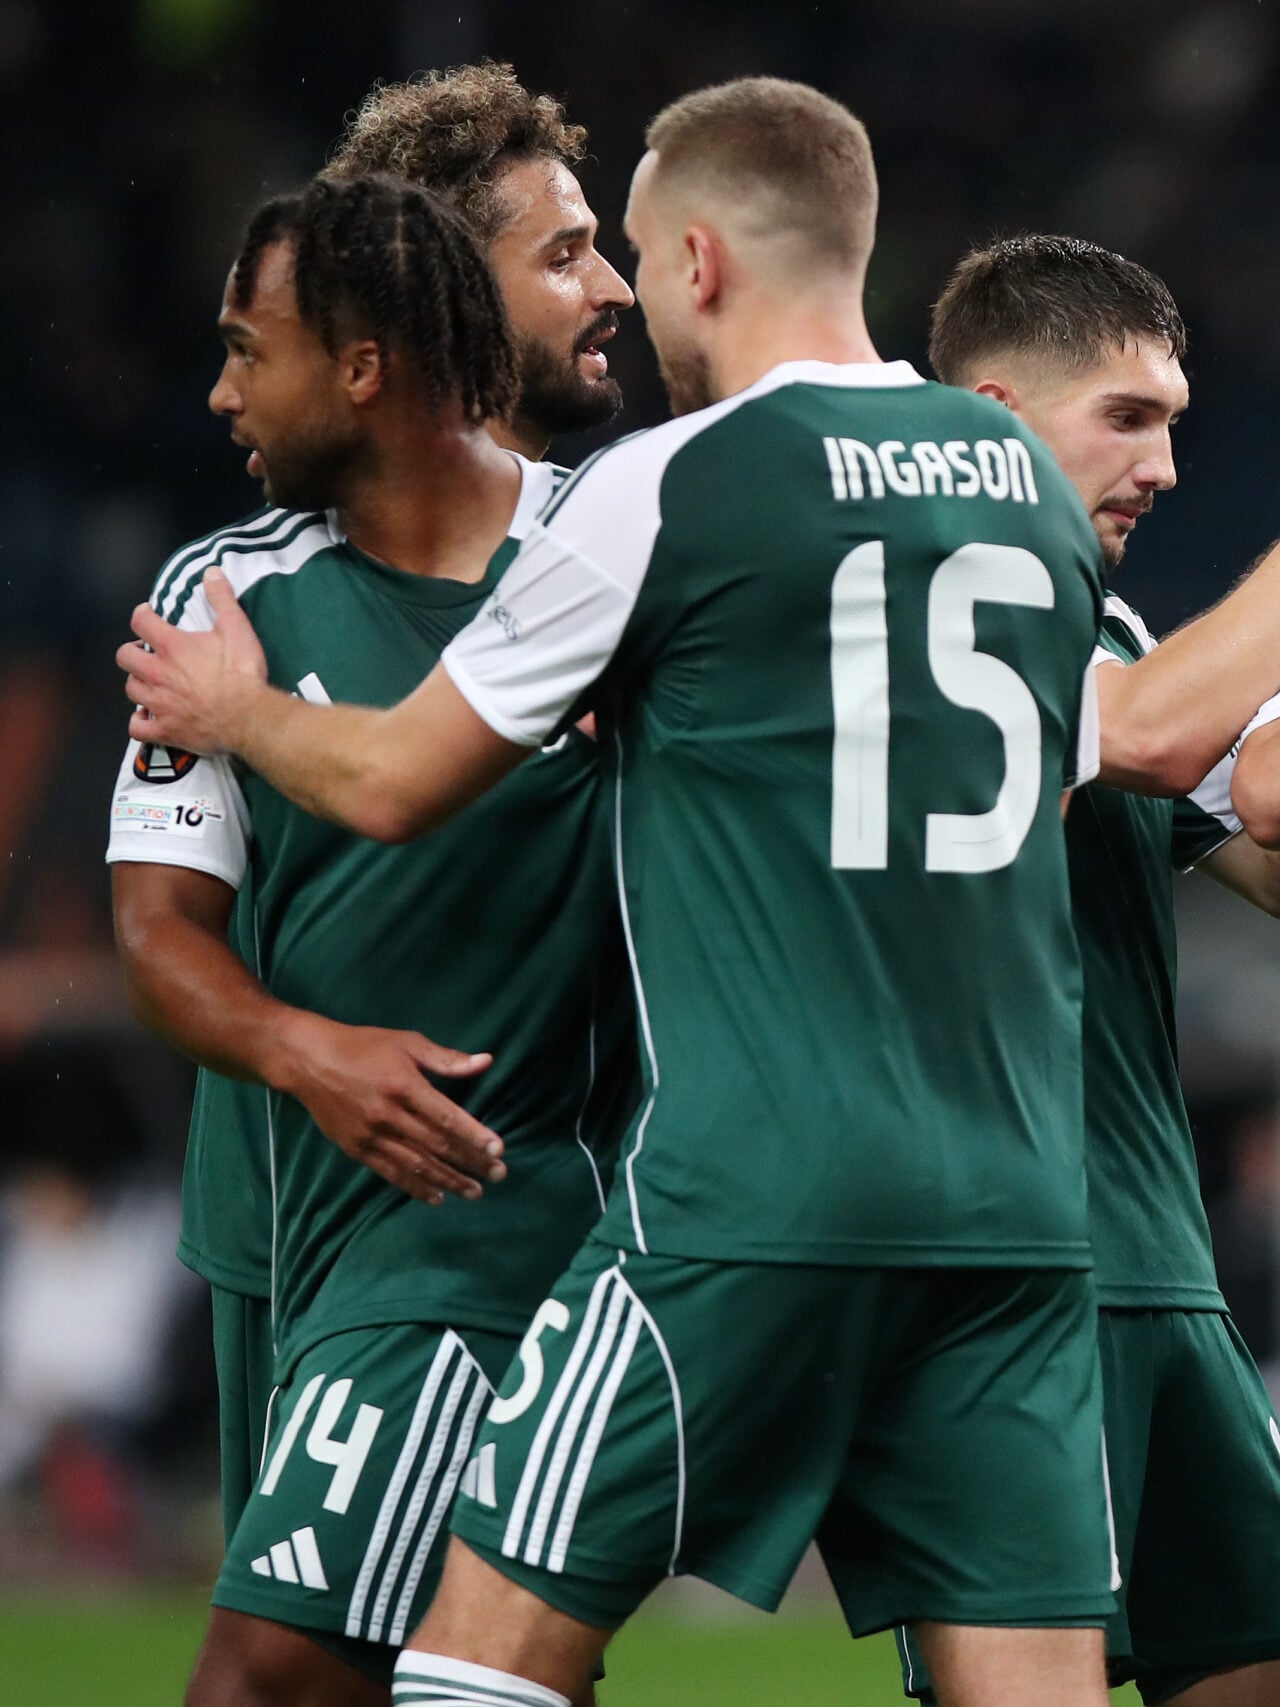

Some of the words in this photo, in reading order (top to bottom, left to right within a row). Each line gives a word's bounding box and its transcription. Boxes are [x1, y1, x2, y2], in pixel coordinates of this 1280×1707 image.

[823, 437, 1039, 504] INGASON
[829, 540, 1055, 874] 15
[115, 807, 172, 819] ATION
[259, 1373, 384, 1515] 14
